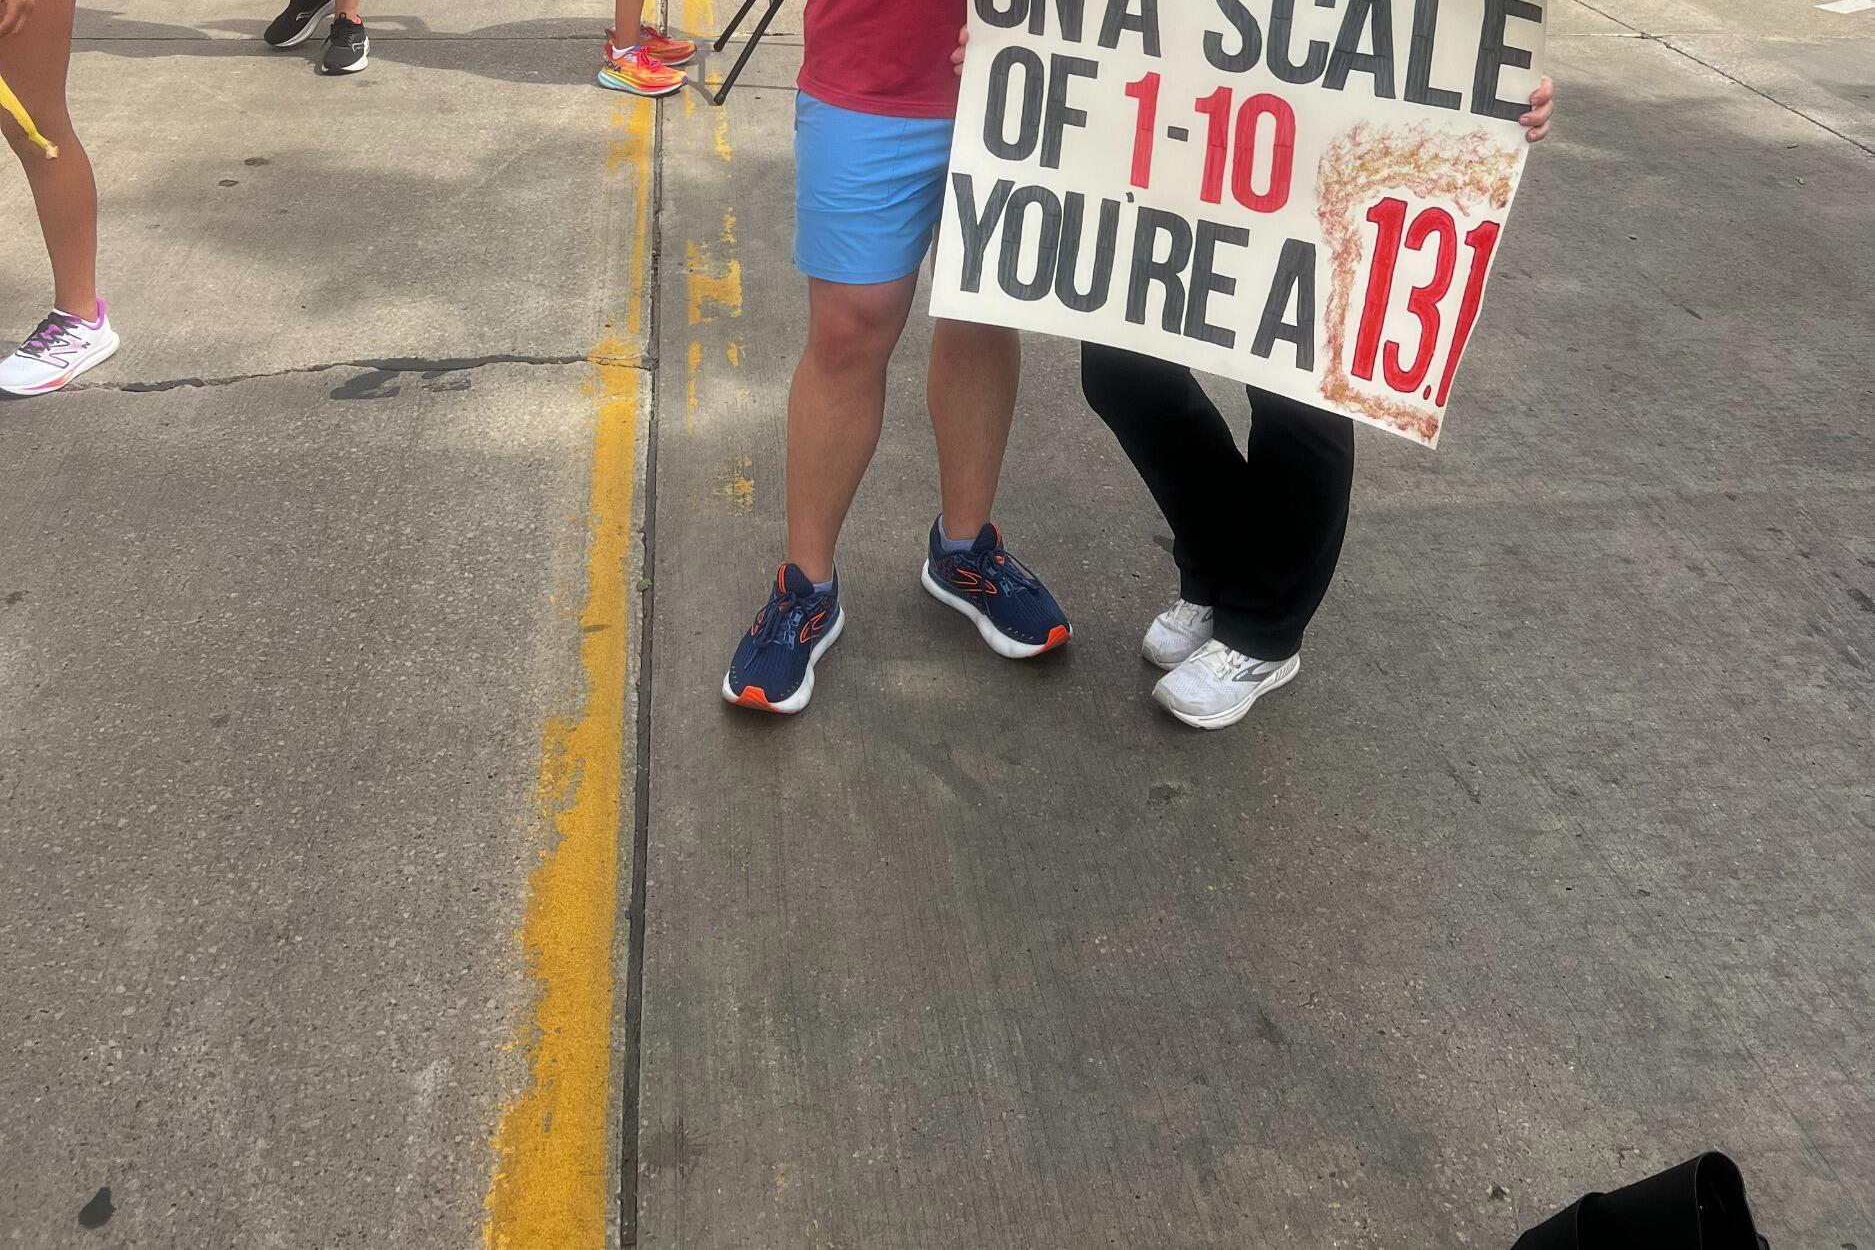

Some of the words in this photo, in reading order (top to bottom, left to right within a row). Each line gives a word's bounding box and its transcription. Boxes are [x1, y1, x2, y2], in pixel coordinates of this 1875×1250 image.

[982, 44, 1099, 169] OF
[1124, 70, 1296, 214] 1-10
[952, 172, 1251, 350] YOU'RE
[1249, 237, 1317, 373] A
[1350, 196, 1501, 409] 13.1
